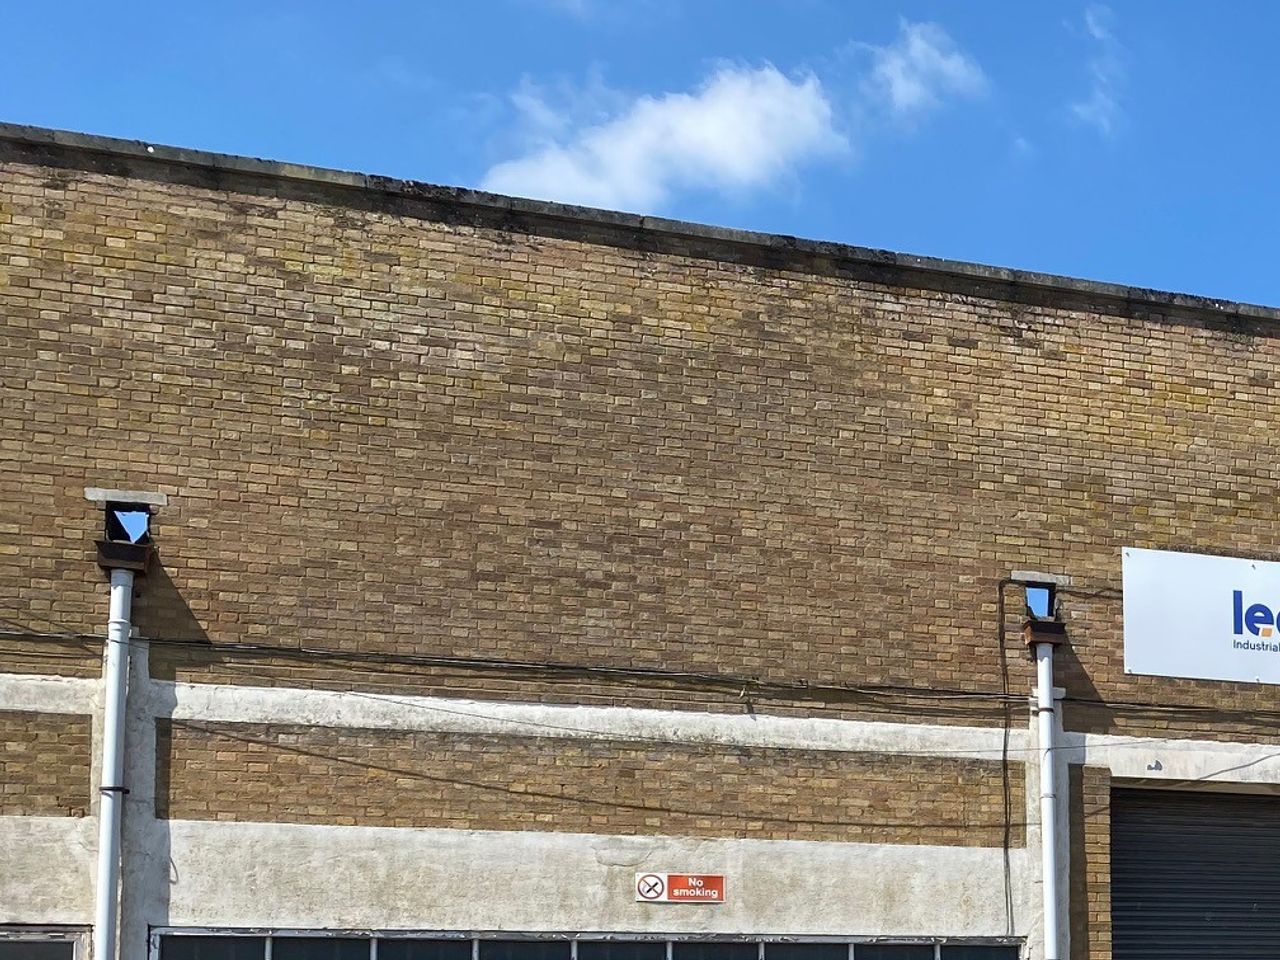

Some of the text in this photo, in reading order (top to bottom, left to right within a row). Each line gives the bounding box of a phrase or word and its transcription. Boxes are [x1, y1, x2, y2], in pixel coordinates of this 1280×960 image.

[1233, 640, 1280, 652] Industrial
[677, 878, 703, 887] No
[673, 888, 718, 898] smoking
